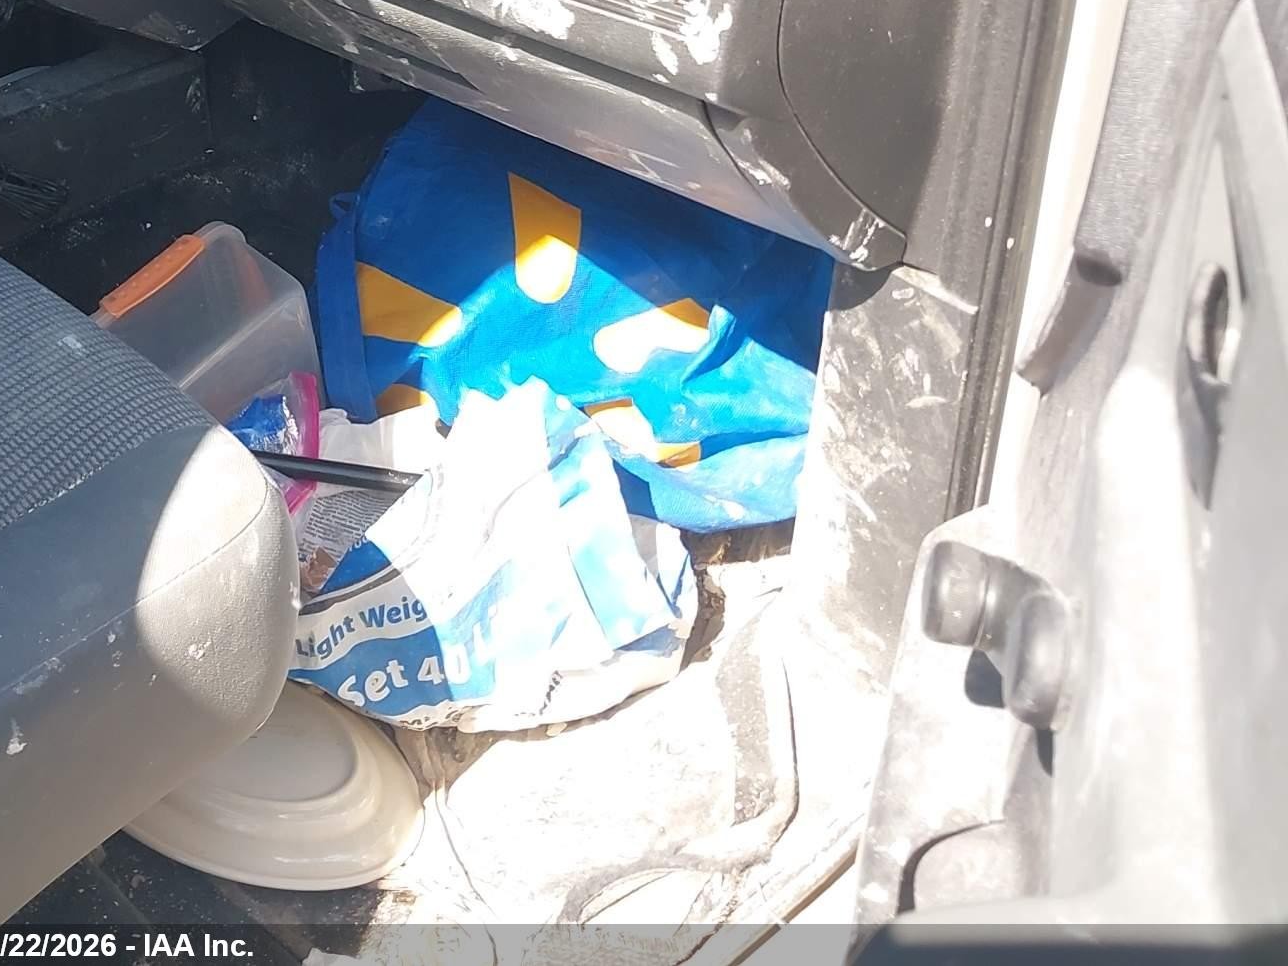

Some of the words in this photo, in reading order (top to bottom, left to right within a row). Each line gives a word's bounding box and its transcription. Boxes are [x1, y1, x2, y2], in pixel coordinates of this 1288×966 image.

[295, 616, 356, 661] Light
[358, 596, 428, 629] Weig
[337, 659, 409, 708] Set
